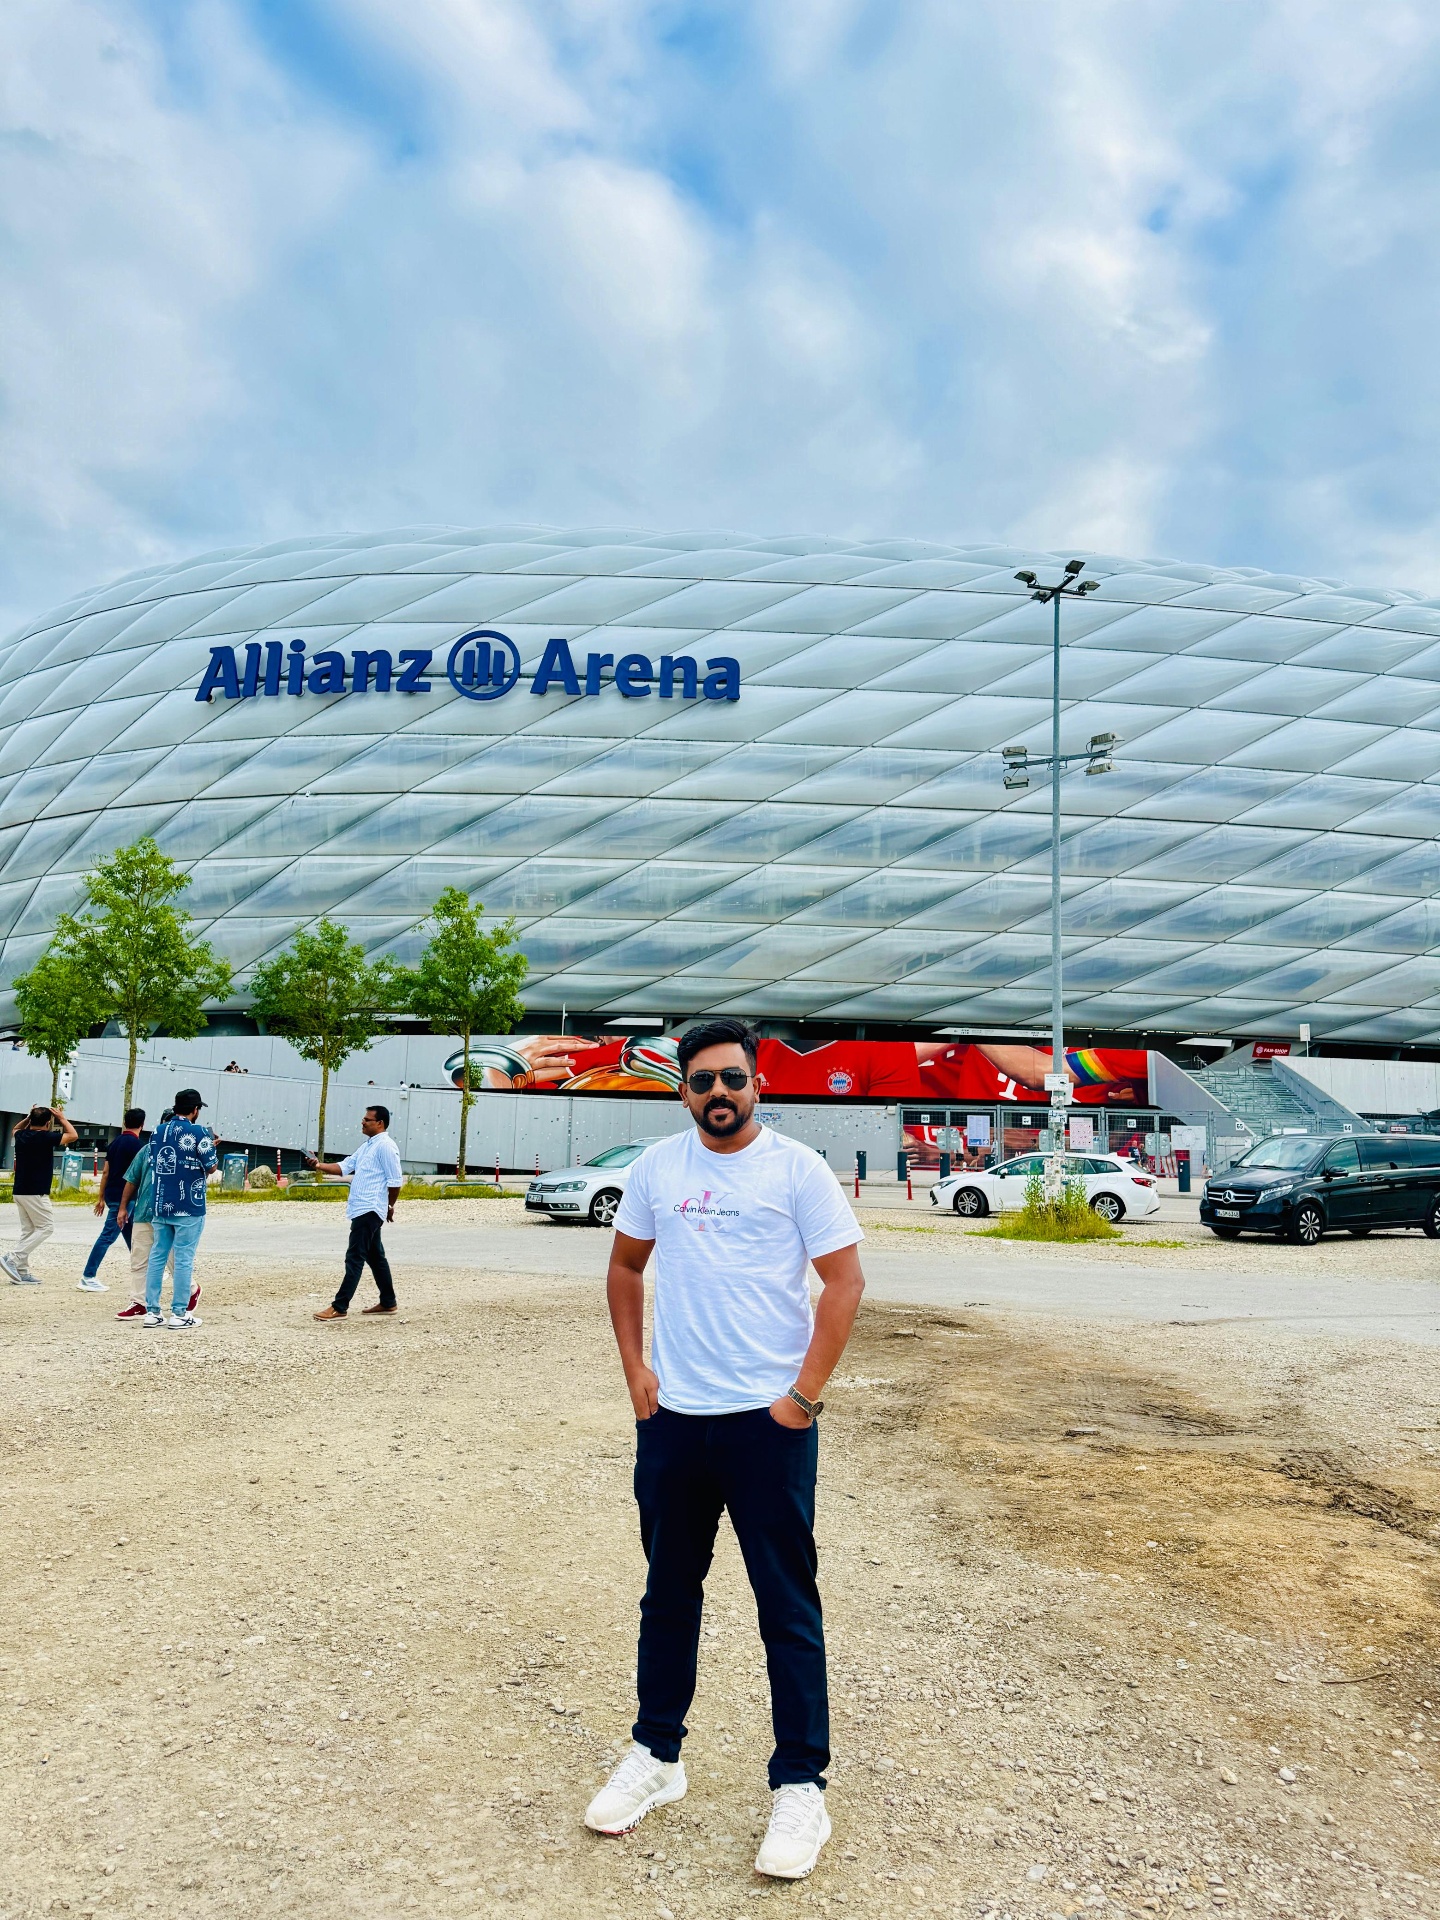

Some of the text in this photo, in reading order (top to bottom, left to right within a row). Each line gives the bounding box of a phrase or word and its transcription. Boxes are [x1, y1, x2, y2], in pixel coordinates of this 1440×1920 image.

[195, 638, 741, 702] Allianz Arena
[673, 1204, 740, 1217] Calvin Klein Jeans
